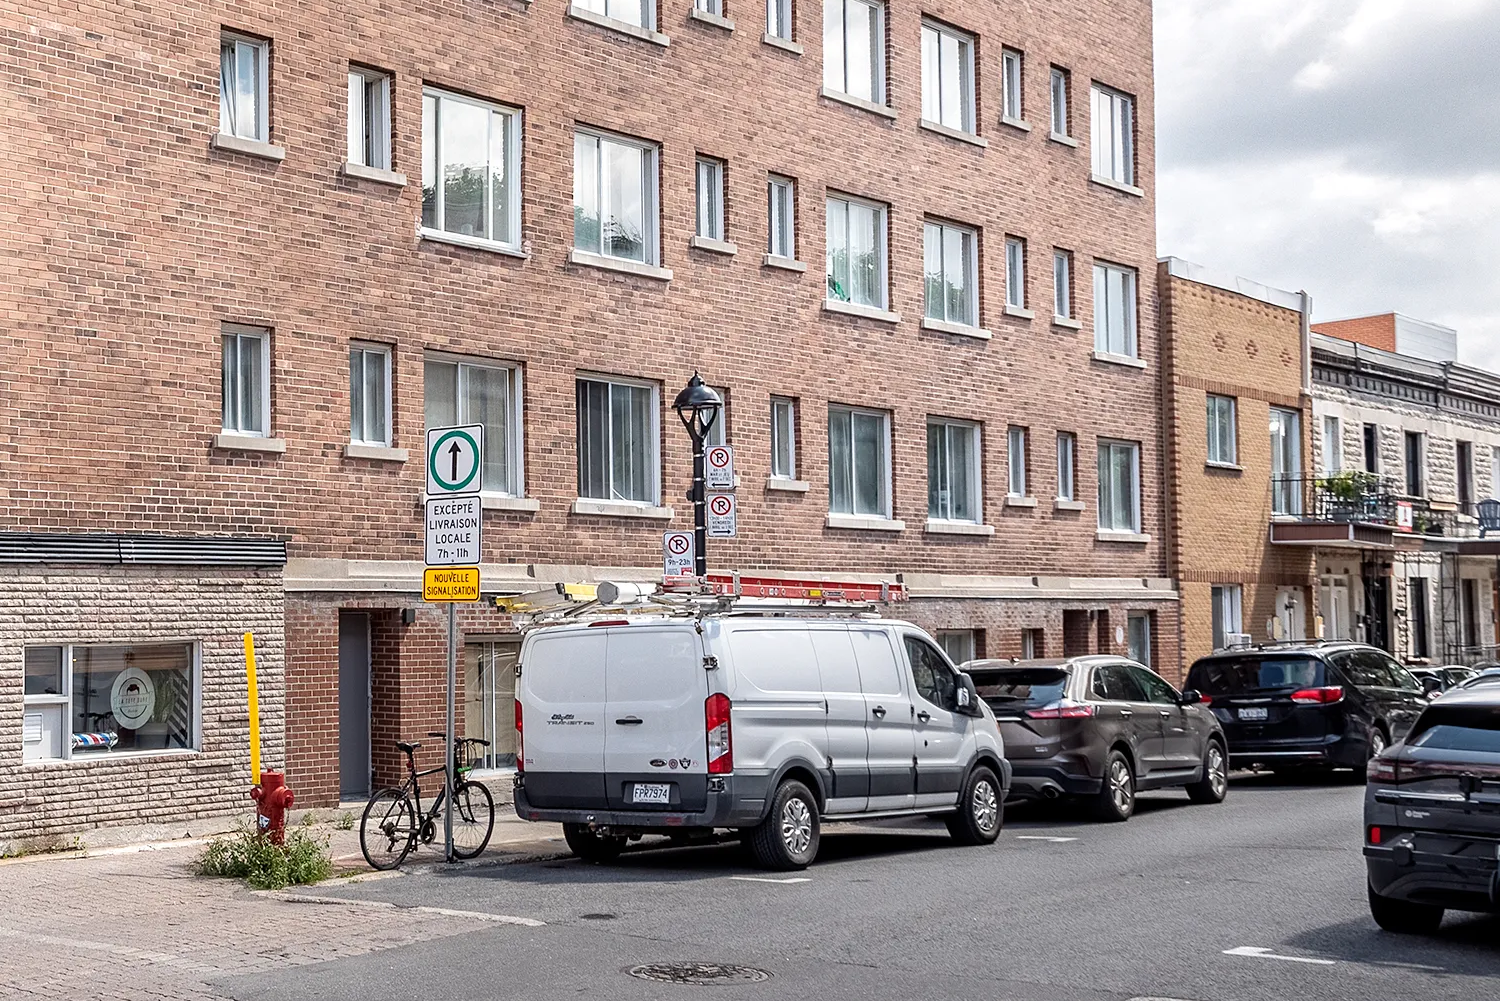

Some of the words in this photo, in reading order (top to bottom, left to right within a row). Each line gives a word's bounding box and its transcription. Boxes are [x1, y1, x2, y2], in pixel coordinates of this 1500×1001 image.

[433, 500, 473, 516] EXCEPTÉ
[429, 518, 477, 530] LIVRAISON
[435, 533, 471, 544] LOCALE
[437, 548, 449, 558] 7h
[456, 548, 469, 558] 11h
[434, 573, 469, 583] NOUVELLE
[426, 585, 477, 596] SIGNALISATION
[634, 787, 668, 799] FPR7974
